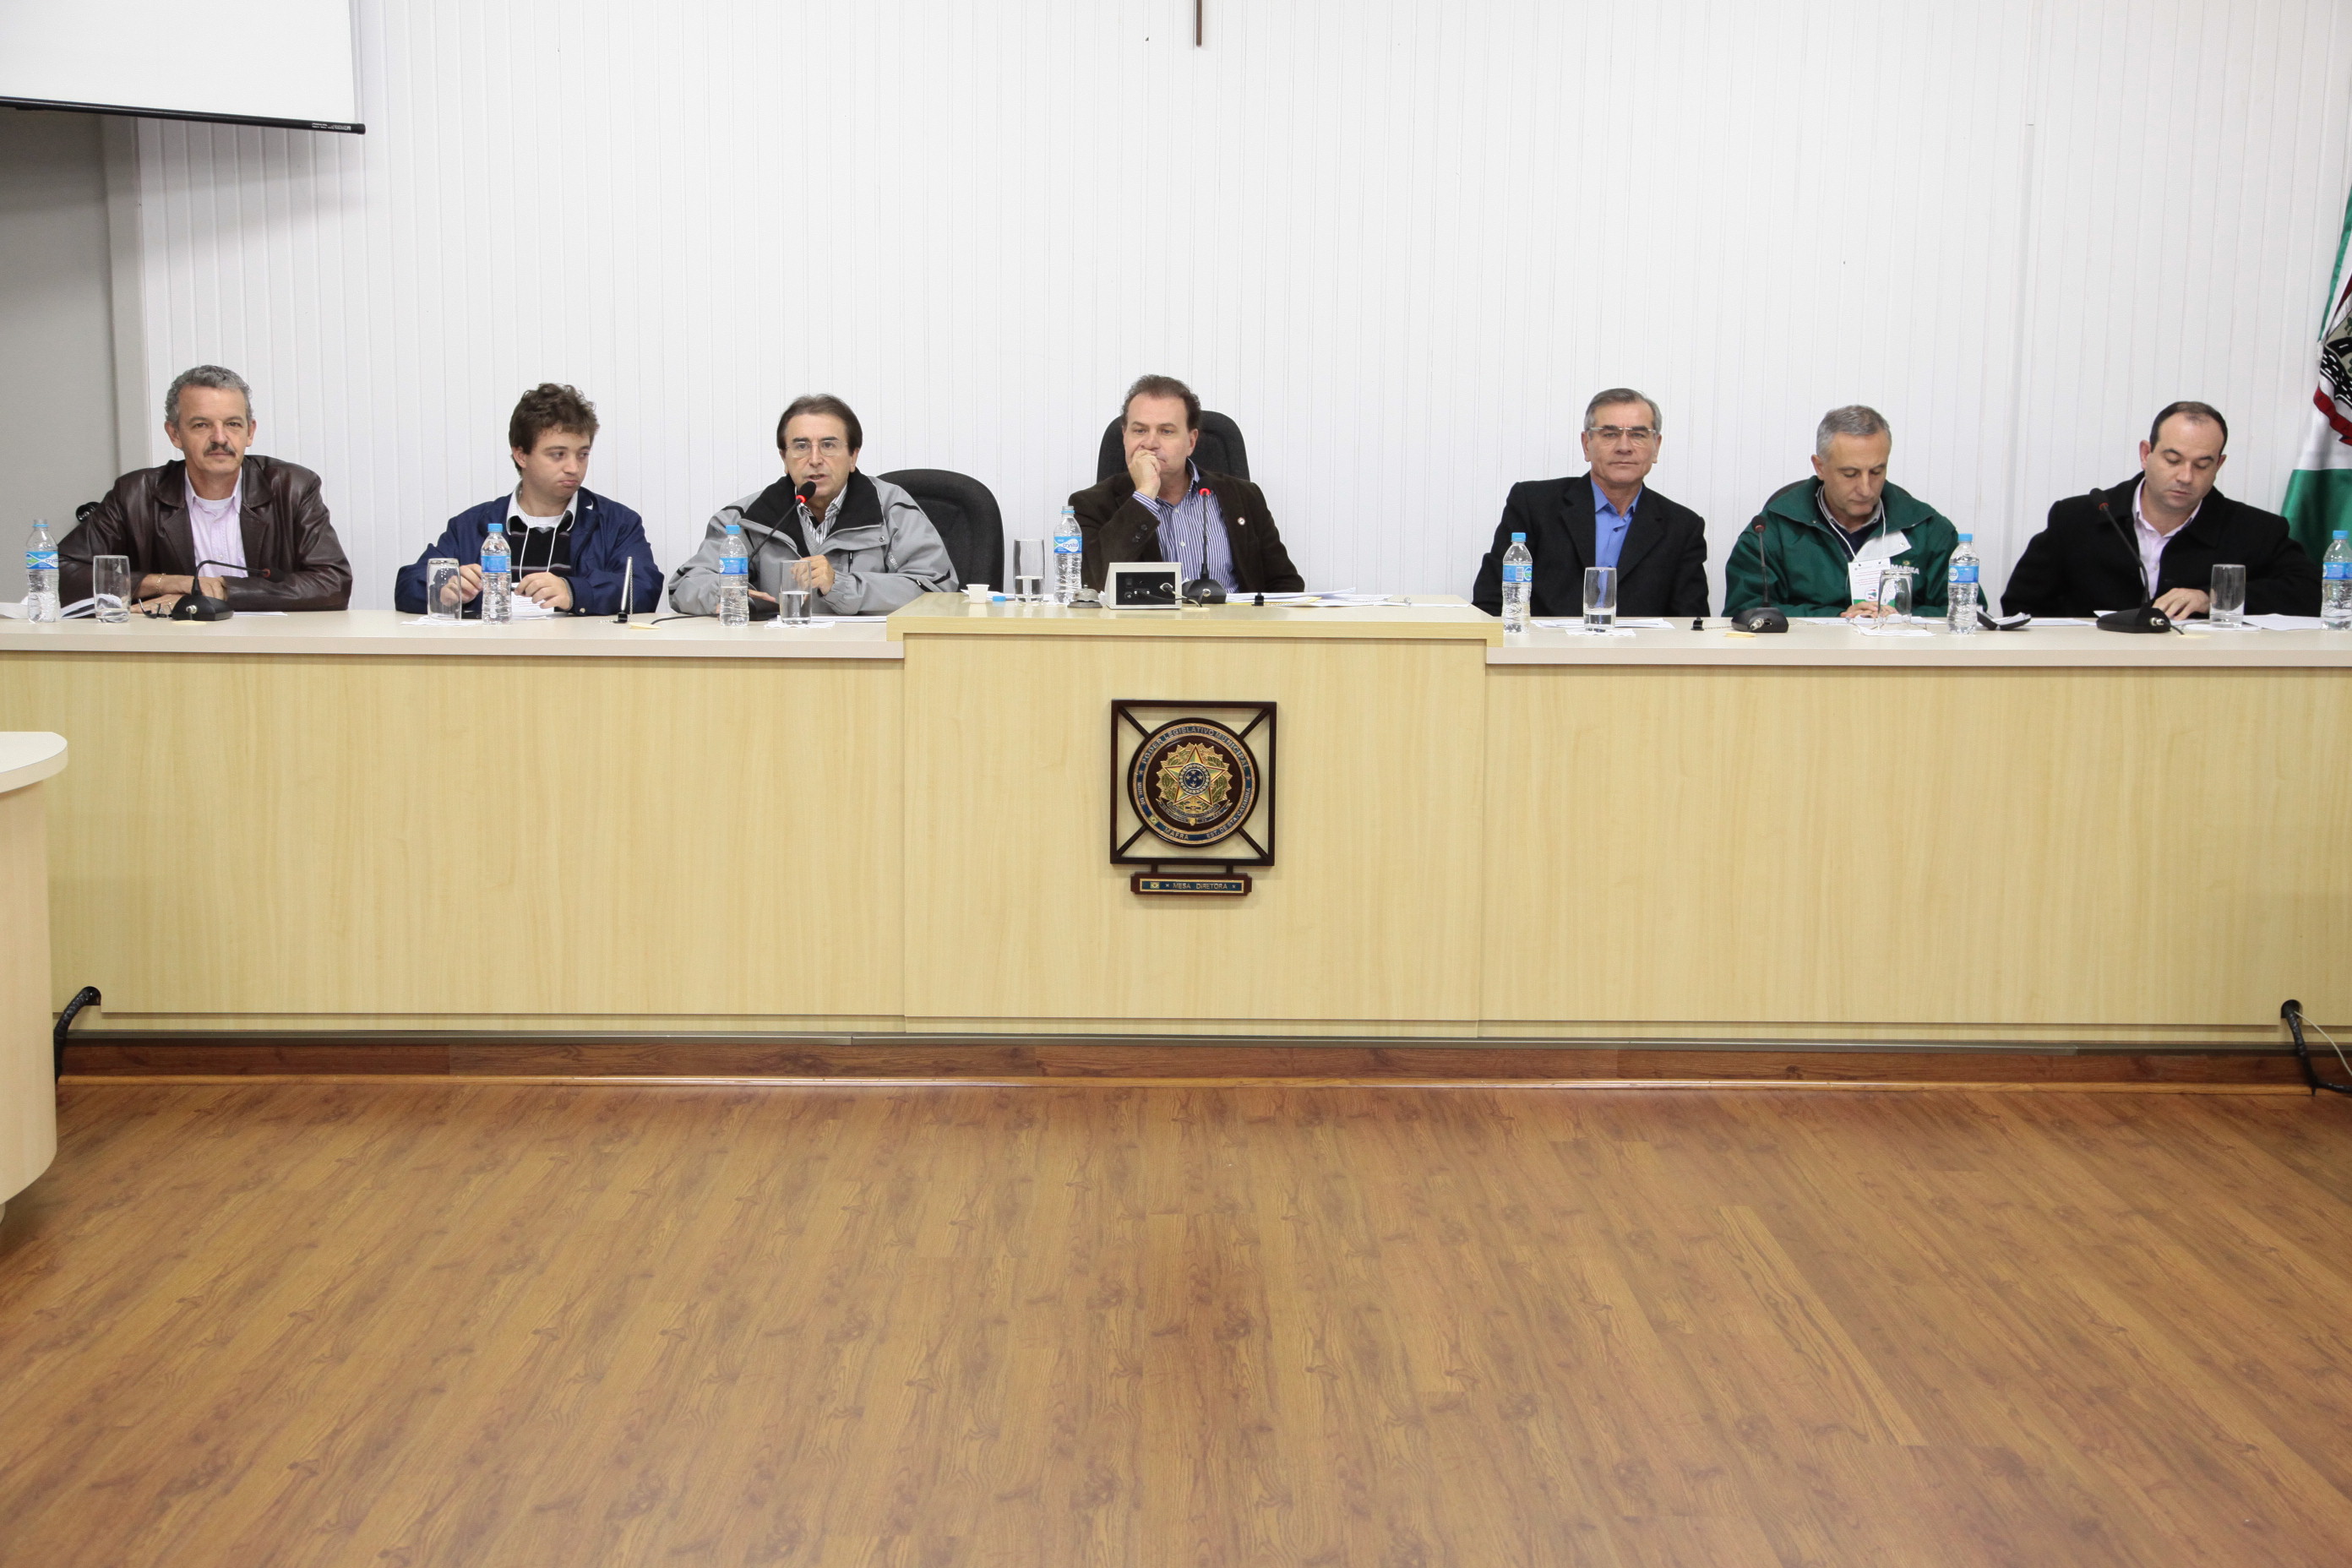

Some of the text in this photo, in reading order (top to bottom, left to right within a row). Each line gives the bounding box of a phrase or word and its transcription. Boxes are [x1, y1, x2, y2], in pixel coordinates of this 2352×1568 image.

[1141, 727, 1249, 770] PODER LEGISLATIVO MUNICIPAL
[1237, 787, 1251, 816] CATARINA
[1164, 828, 1190, 841] MAFRA
